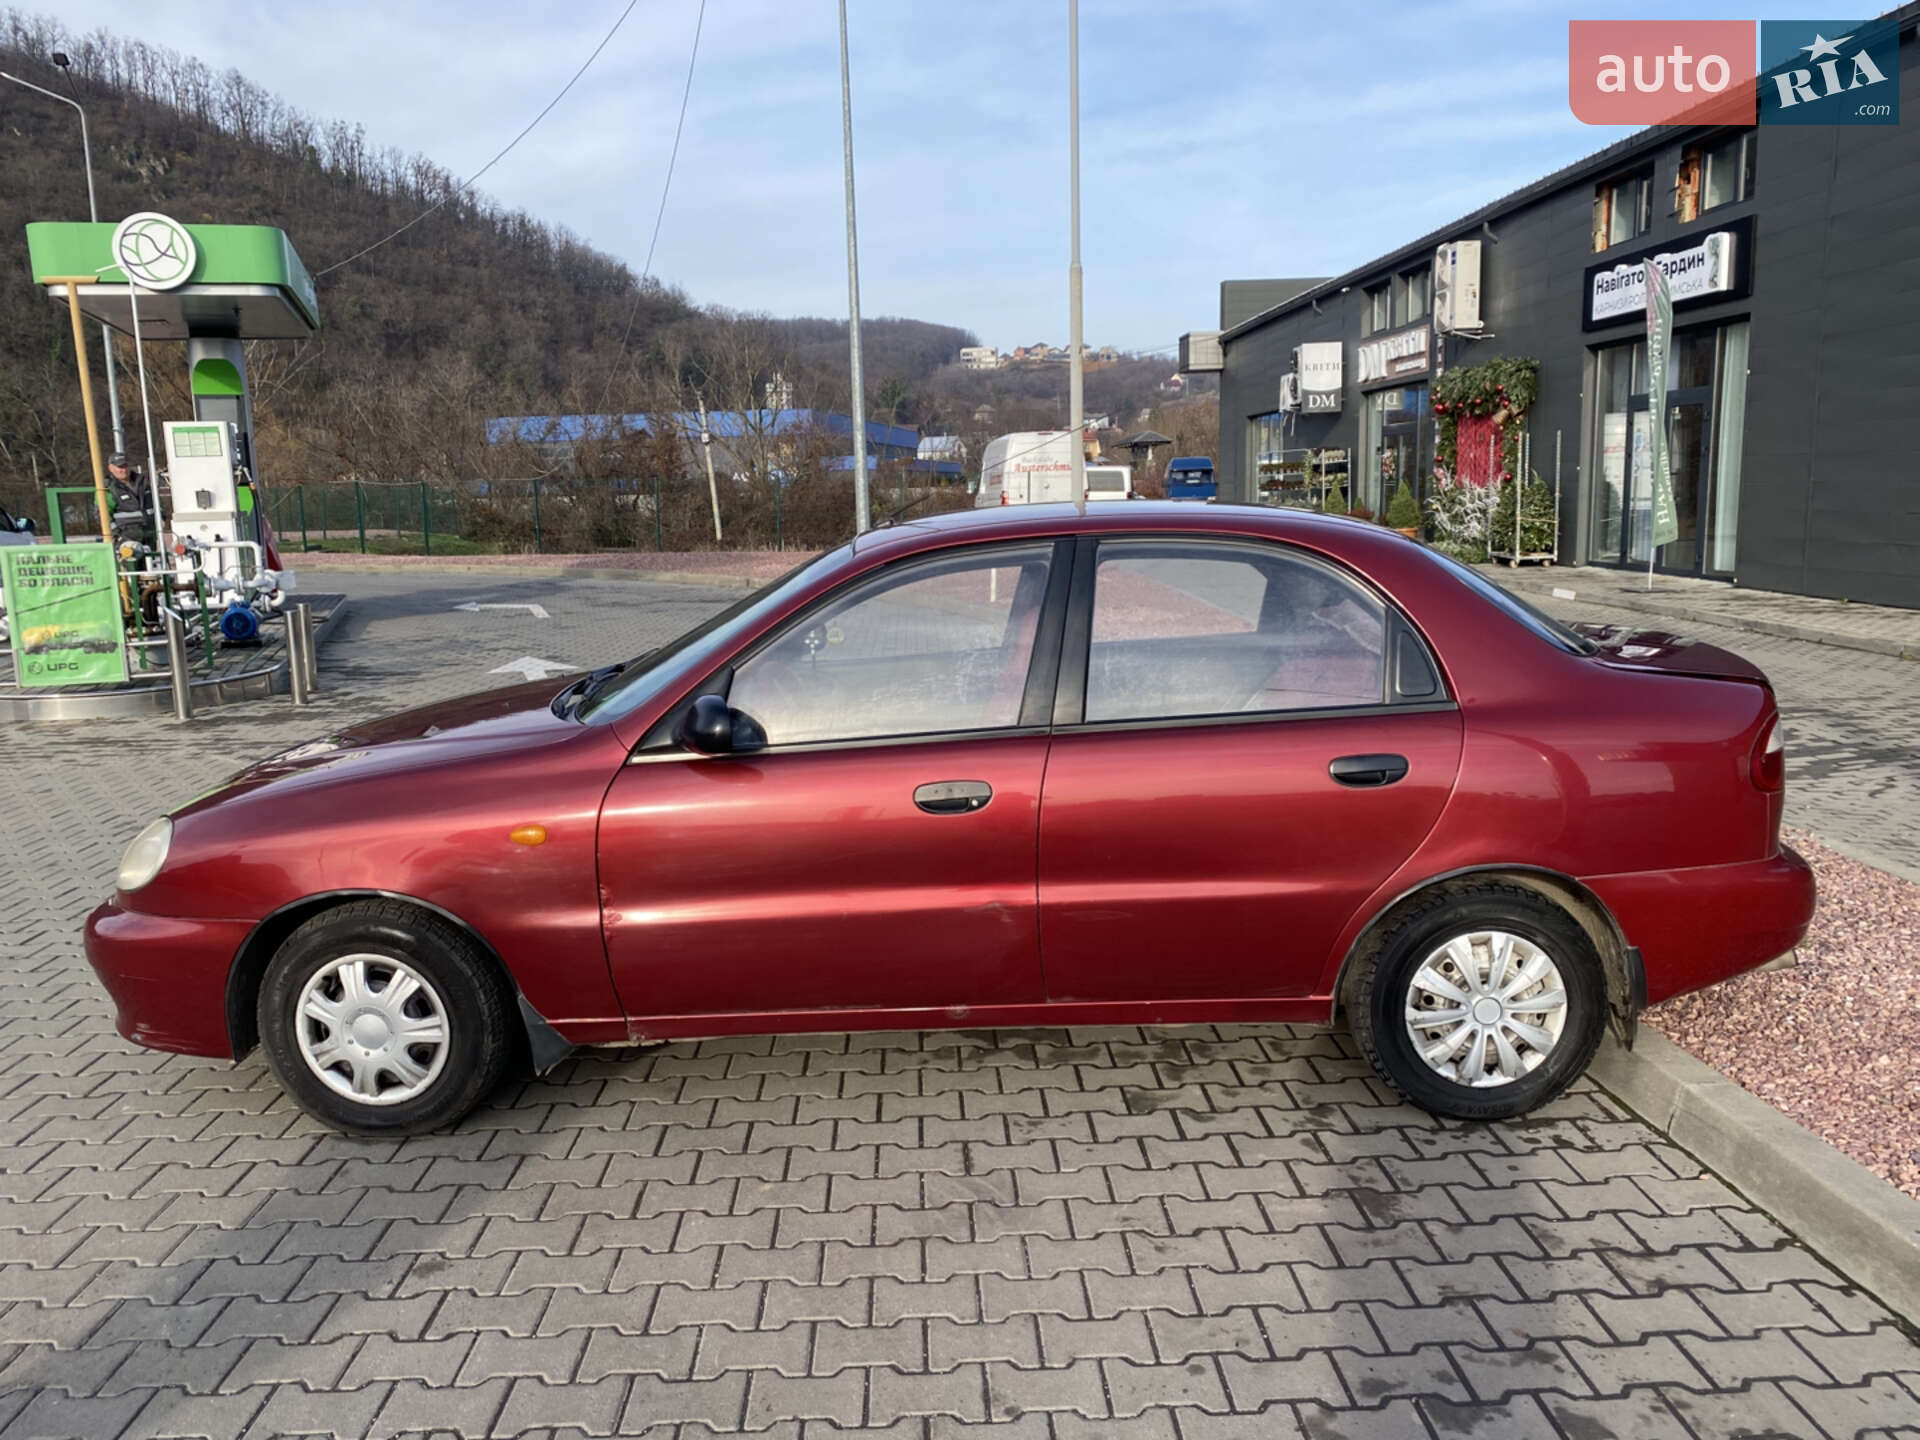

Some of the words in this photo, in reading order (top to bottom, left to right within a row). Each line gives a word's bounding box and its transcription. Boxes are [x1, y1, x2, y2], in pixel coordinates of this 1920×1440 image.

[1596, 269, 1645, 295] Навігато
[1308, 393, 1336, 409] DM
[46, 662, 79, 671] UPG
